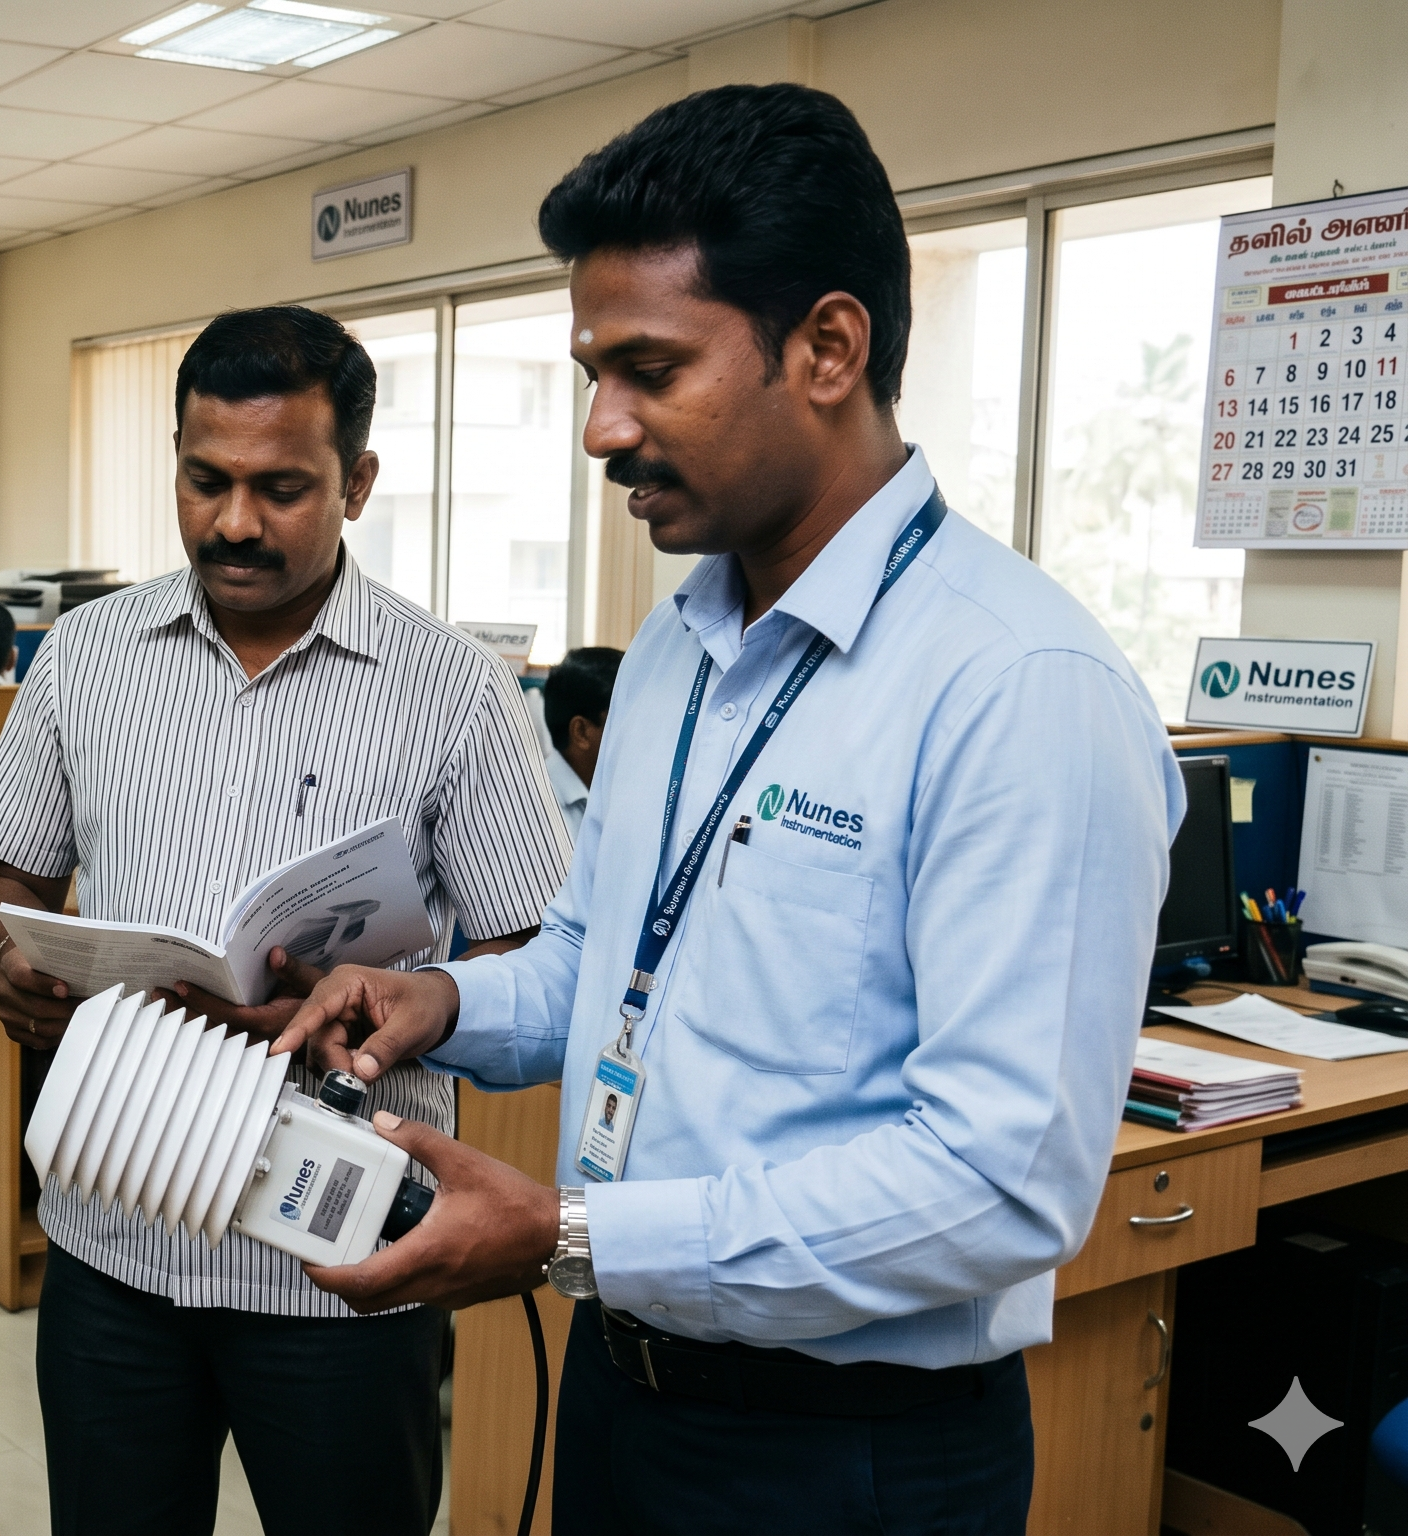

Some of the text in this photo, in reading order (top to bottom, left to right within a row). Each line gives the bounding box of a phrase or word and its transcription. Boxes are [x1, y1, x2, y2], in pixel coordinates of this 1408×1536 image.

[344, 192, 401, 223] Nunes
[1289, 322, 1397, 350] 1 2 3 4
[1224, 356, 1398, 387] 6 7 8 9 10 11
[1217, 389, 1397, 418] 13 14 15 16 17 18
[1213, 431, 1236, 450] 20
[1244, 430, 1265, 449] 21
[1274, 428, 1298, 448] 22
[1306, 427, 1329, 447] 23
[1337, 425, 1361, 445] 24
[1370, 423, 1394, 444] 25
[1211, 458, 1357, 482] 27 28 29 30 31
[1248, 661, 1356, 690] Nunes
[1244, 691, 1353, 708] Instrumentation
[785, 789, 864, 833] Nunes
[780, 814, 862, 850] Instrumentation
